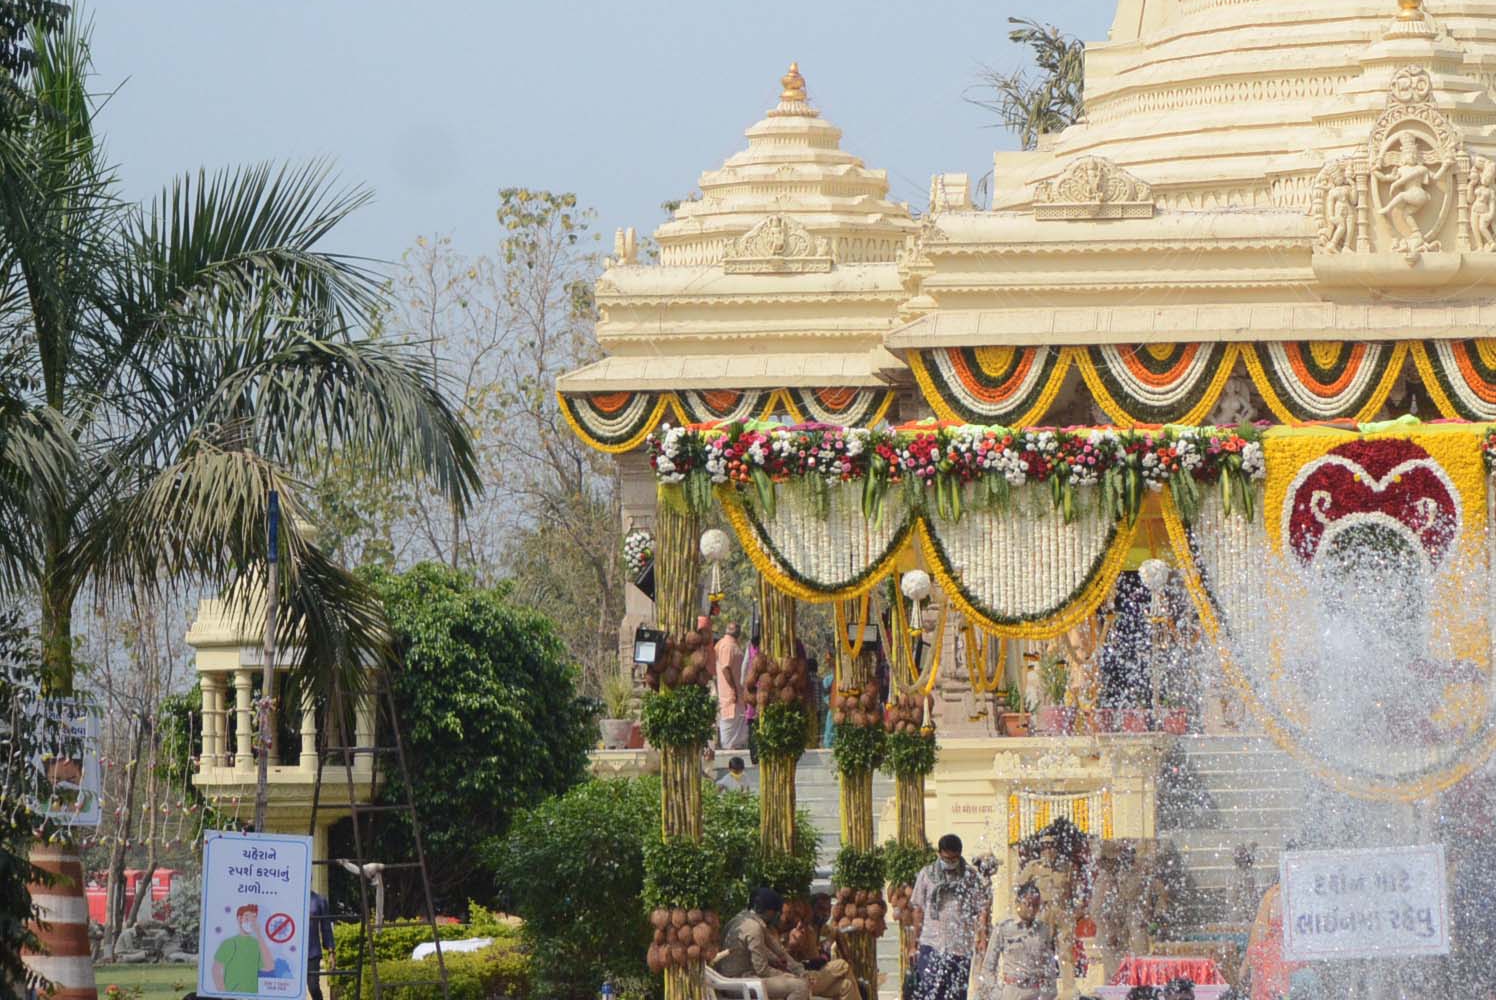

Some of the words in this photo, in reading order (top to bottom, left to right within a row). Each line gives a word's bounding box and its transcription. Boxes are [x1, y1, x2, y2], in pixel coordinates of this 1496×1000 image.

[242, 846, 278, 861] ચહેરાને
[228, 864, 253, 878] સ્પર્શ
[256, 864, 291, 882] કરવાનું
